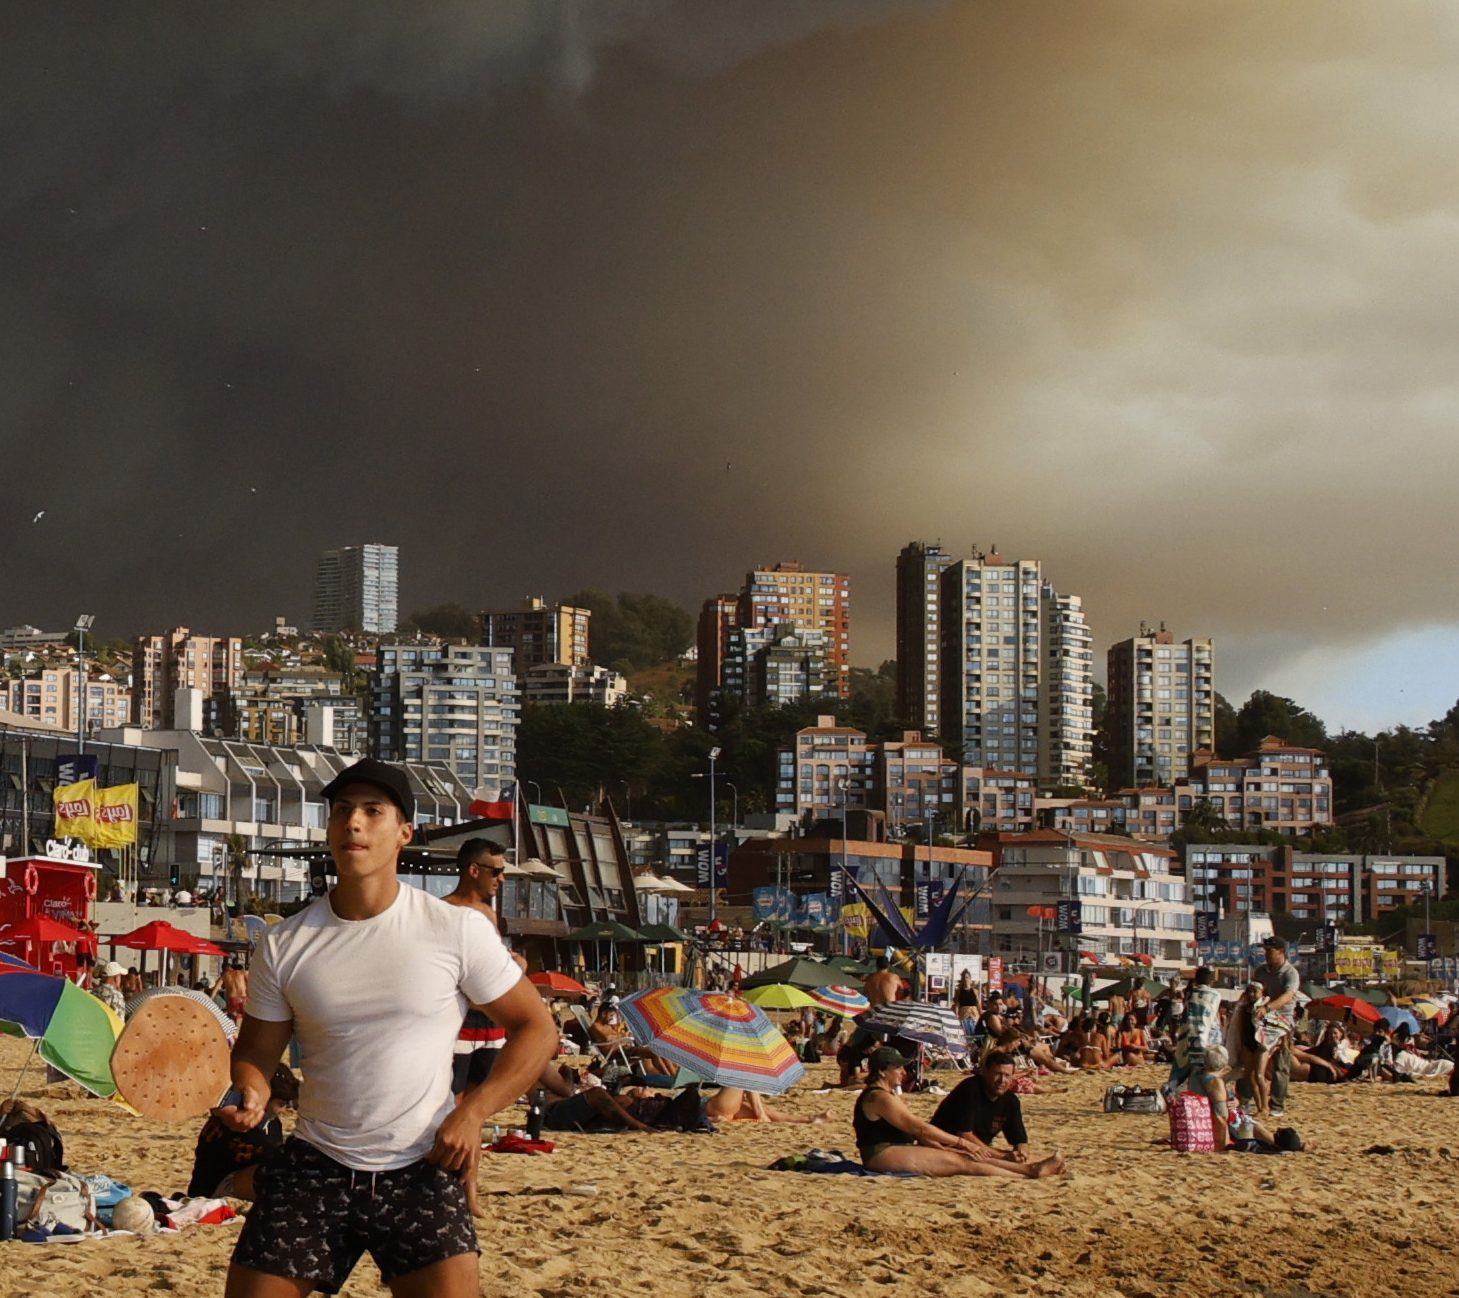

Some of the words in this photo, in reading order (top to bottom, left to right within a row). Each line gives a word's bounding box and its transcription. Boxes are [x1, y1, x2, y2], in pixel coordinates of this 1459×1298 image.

[698, 849, 710, 884] WOM
[917, 885, 929, 914] WOM
[1058, 904, 1069, 930] WOM
